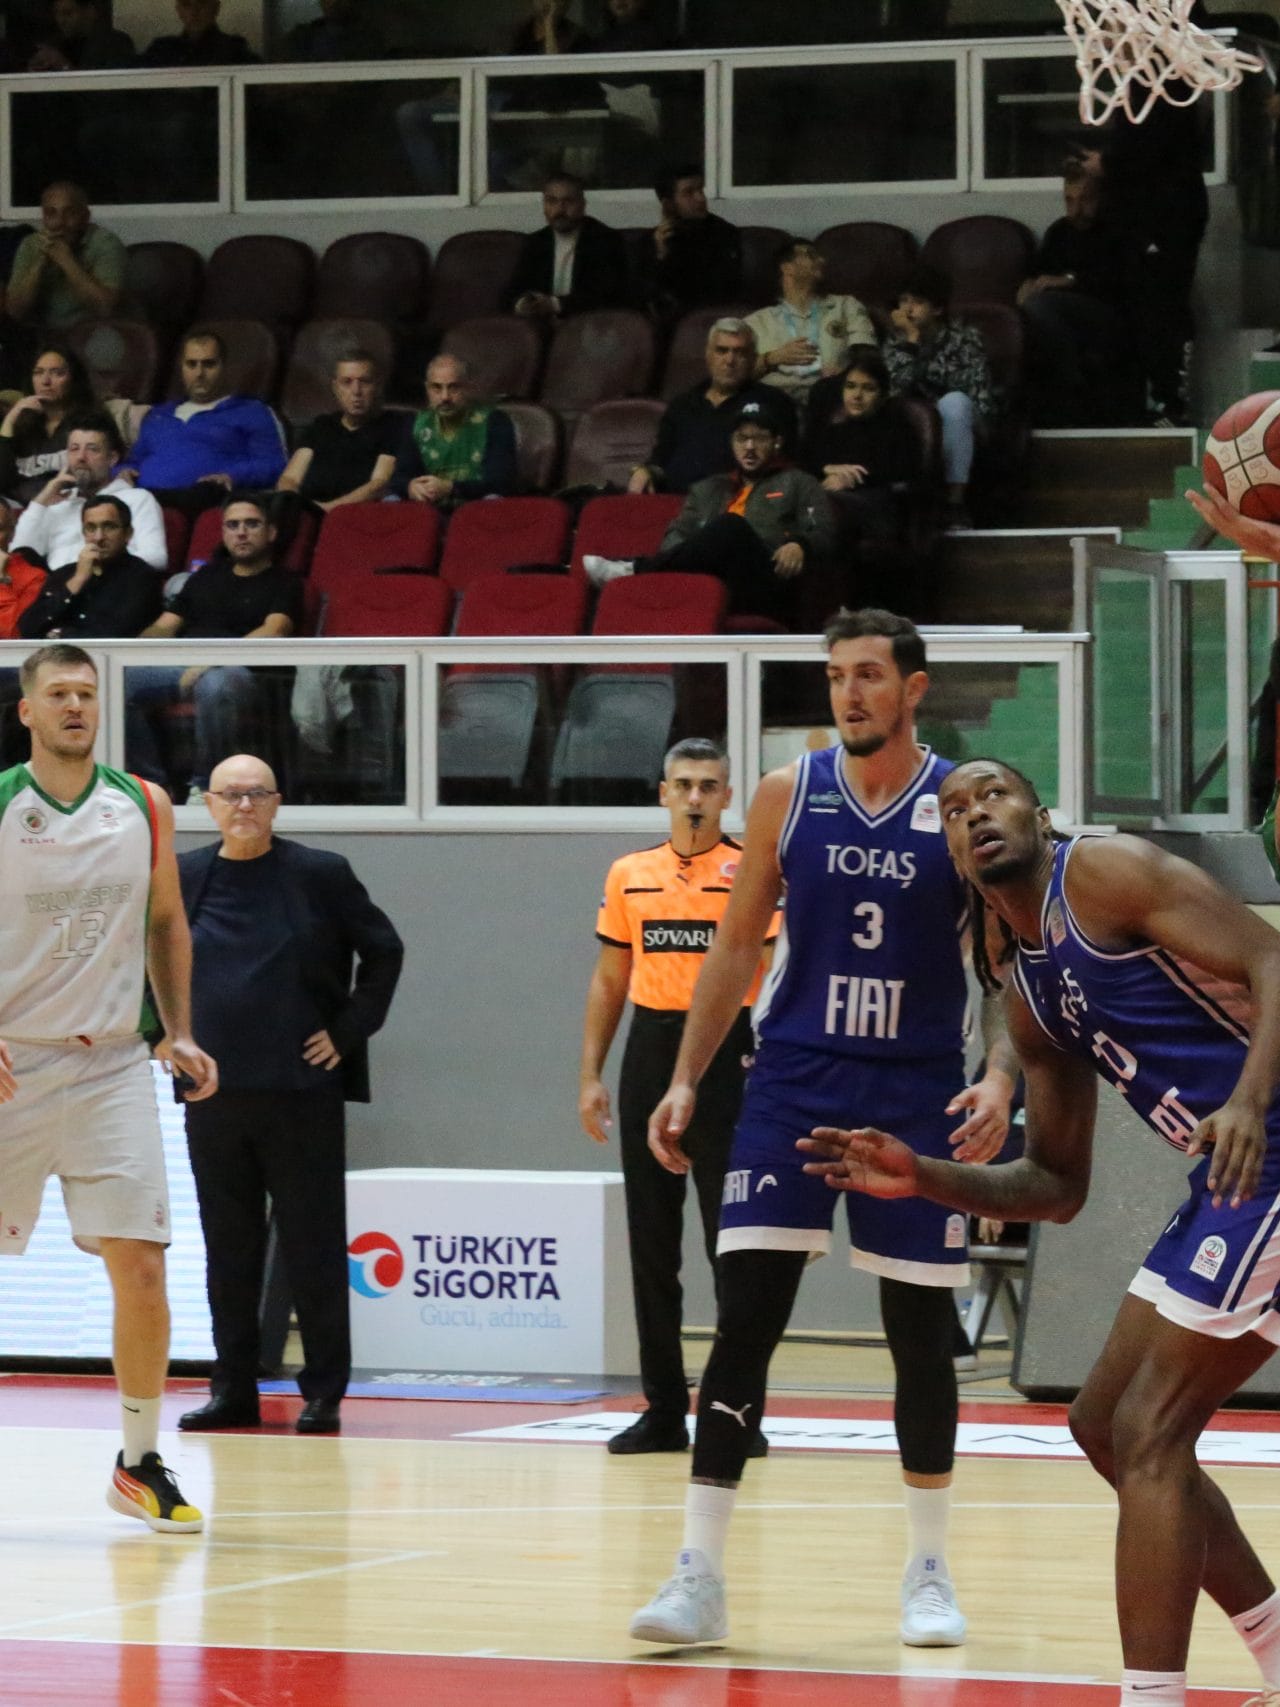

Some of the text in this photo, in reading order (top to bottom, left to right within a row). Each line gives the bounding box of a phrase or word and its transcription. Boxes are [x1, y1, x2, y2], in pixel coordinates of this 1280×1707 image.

[825, 844, 917, 889] TOFAŞ
[851, 901, 885, 950] 3
[824, 973, 905, 1040] FIAT
